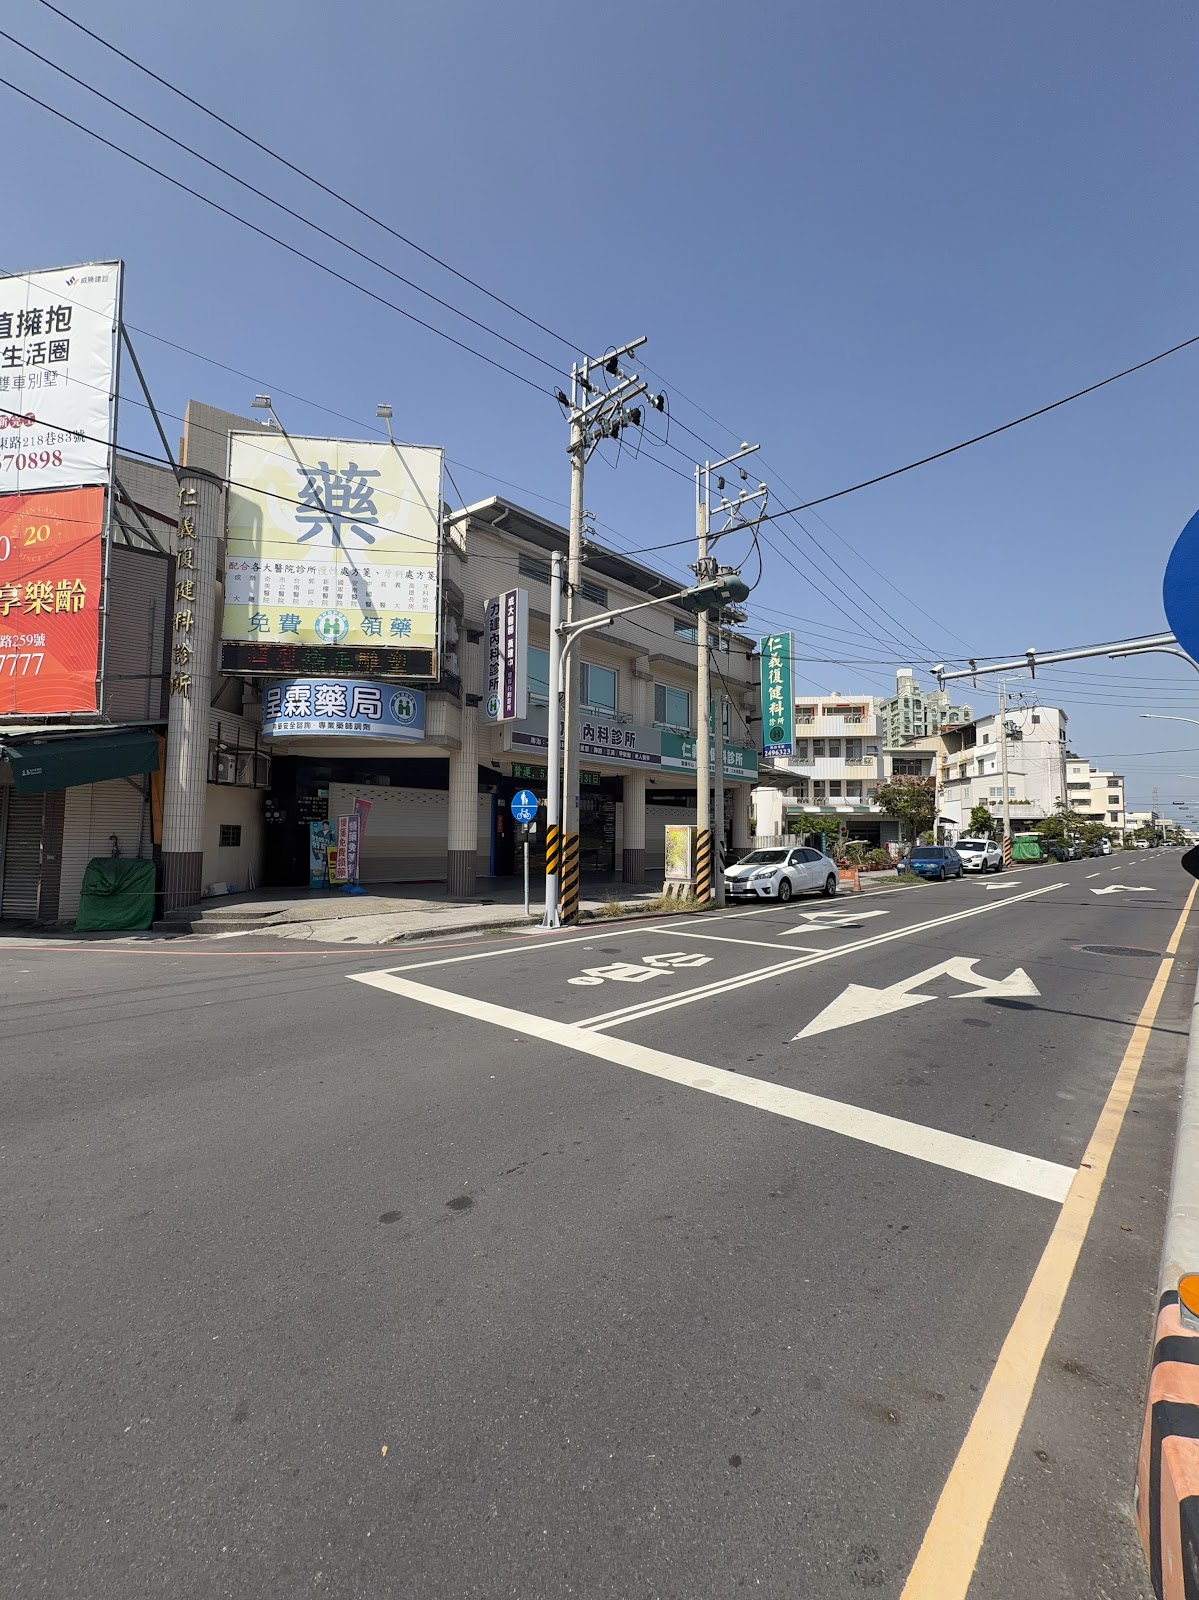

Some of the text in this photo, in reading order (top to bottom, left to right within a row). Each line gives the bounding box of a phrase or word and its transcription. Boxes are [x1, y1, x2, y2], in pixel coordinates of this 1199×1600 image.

[2, 339, 70, 368] 生活圈
[0, 449, 63, 472] 70898
[295, 461, 381, 547] 藥
[24, 524, 51, 547] 20
[171, 487, 198, 699] 仁義復健科診所
[248, 611, 412, 638] 免費 領藥
[489, 603, 499, 691] 力建內科診所
